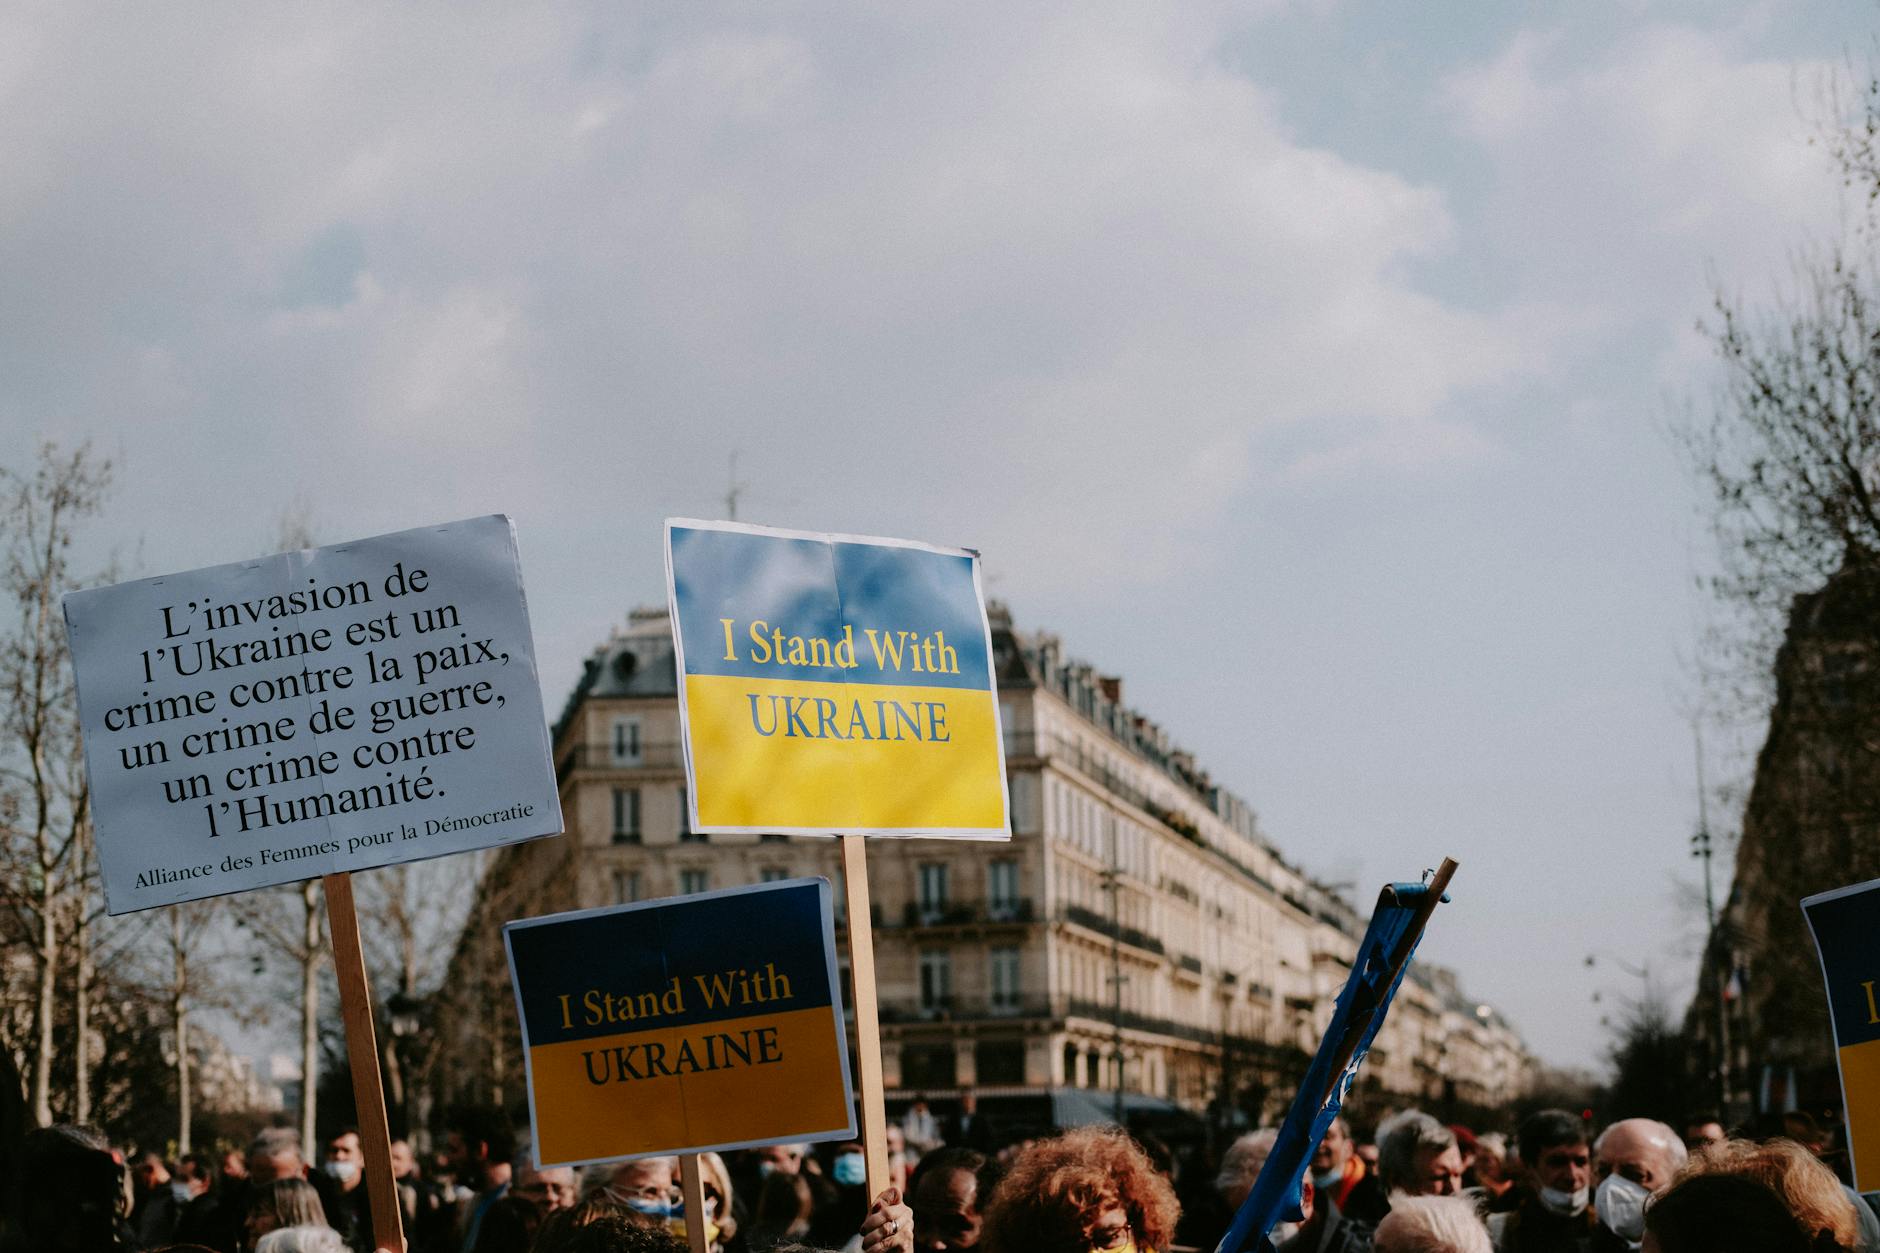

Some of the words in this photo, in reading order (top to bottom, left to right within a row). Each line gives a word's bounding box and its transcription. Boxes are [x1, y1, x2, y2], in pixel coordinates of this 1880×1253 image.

[384, 563, 429, 595] de
[345, 614, 401, 646] est
[413, 605, 462, 634] un
[719, 619, 738, 661] I
[750, 621, 857, 670] Stand
[864, 629, 960, 674] With
[104, 691, 216, 732] crime
[230, 664, 354, 705] contre
[368, 651, 402, 684] la
[414, 633, 510, 684] paix,
[120, 740, 167, 770] un
[182, 716, 296, 758] crime
[309, 700, 356, 735] de
[370, 680, 505, 733] guerre,
[747, 694, 951, 743] UKRAINE
[163, 774, 213, 803] un
[226, 751, 339, 792] crime
[353, 726, 475, 769] contre
[135, 861, 213, 890] Alliance
[220, 854, 254, 873] des
[260, 838, 340, 866] Femmes
[348, 829, 394, 855] pour
[401, 824, 418, 840] la
[424, 803, 534, 837] Démocratie
[559, 995, 575, 1030] I
[584, 977, 687, 1027] Stand
[694, 963, 794, 1007] With
[1861, 980, 1880, 1025] I
[581, 1027, 783, 1086] UKRAINE
